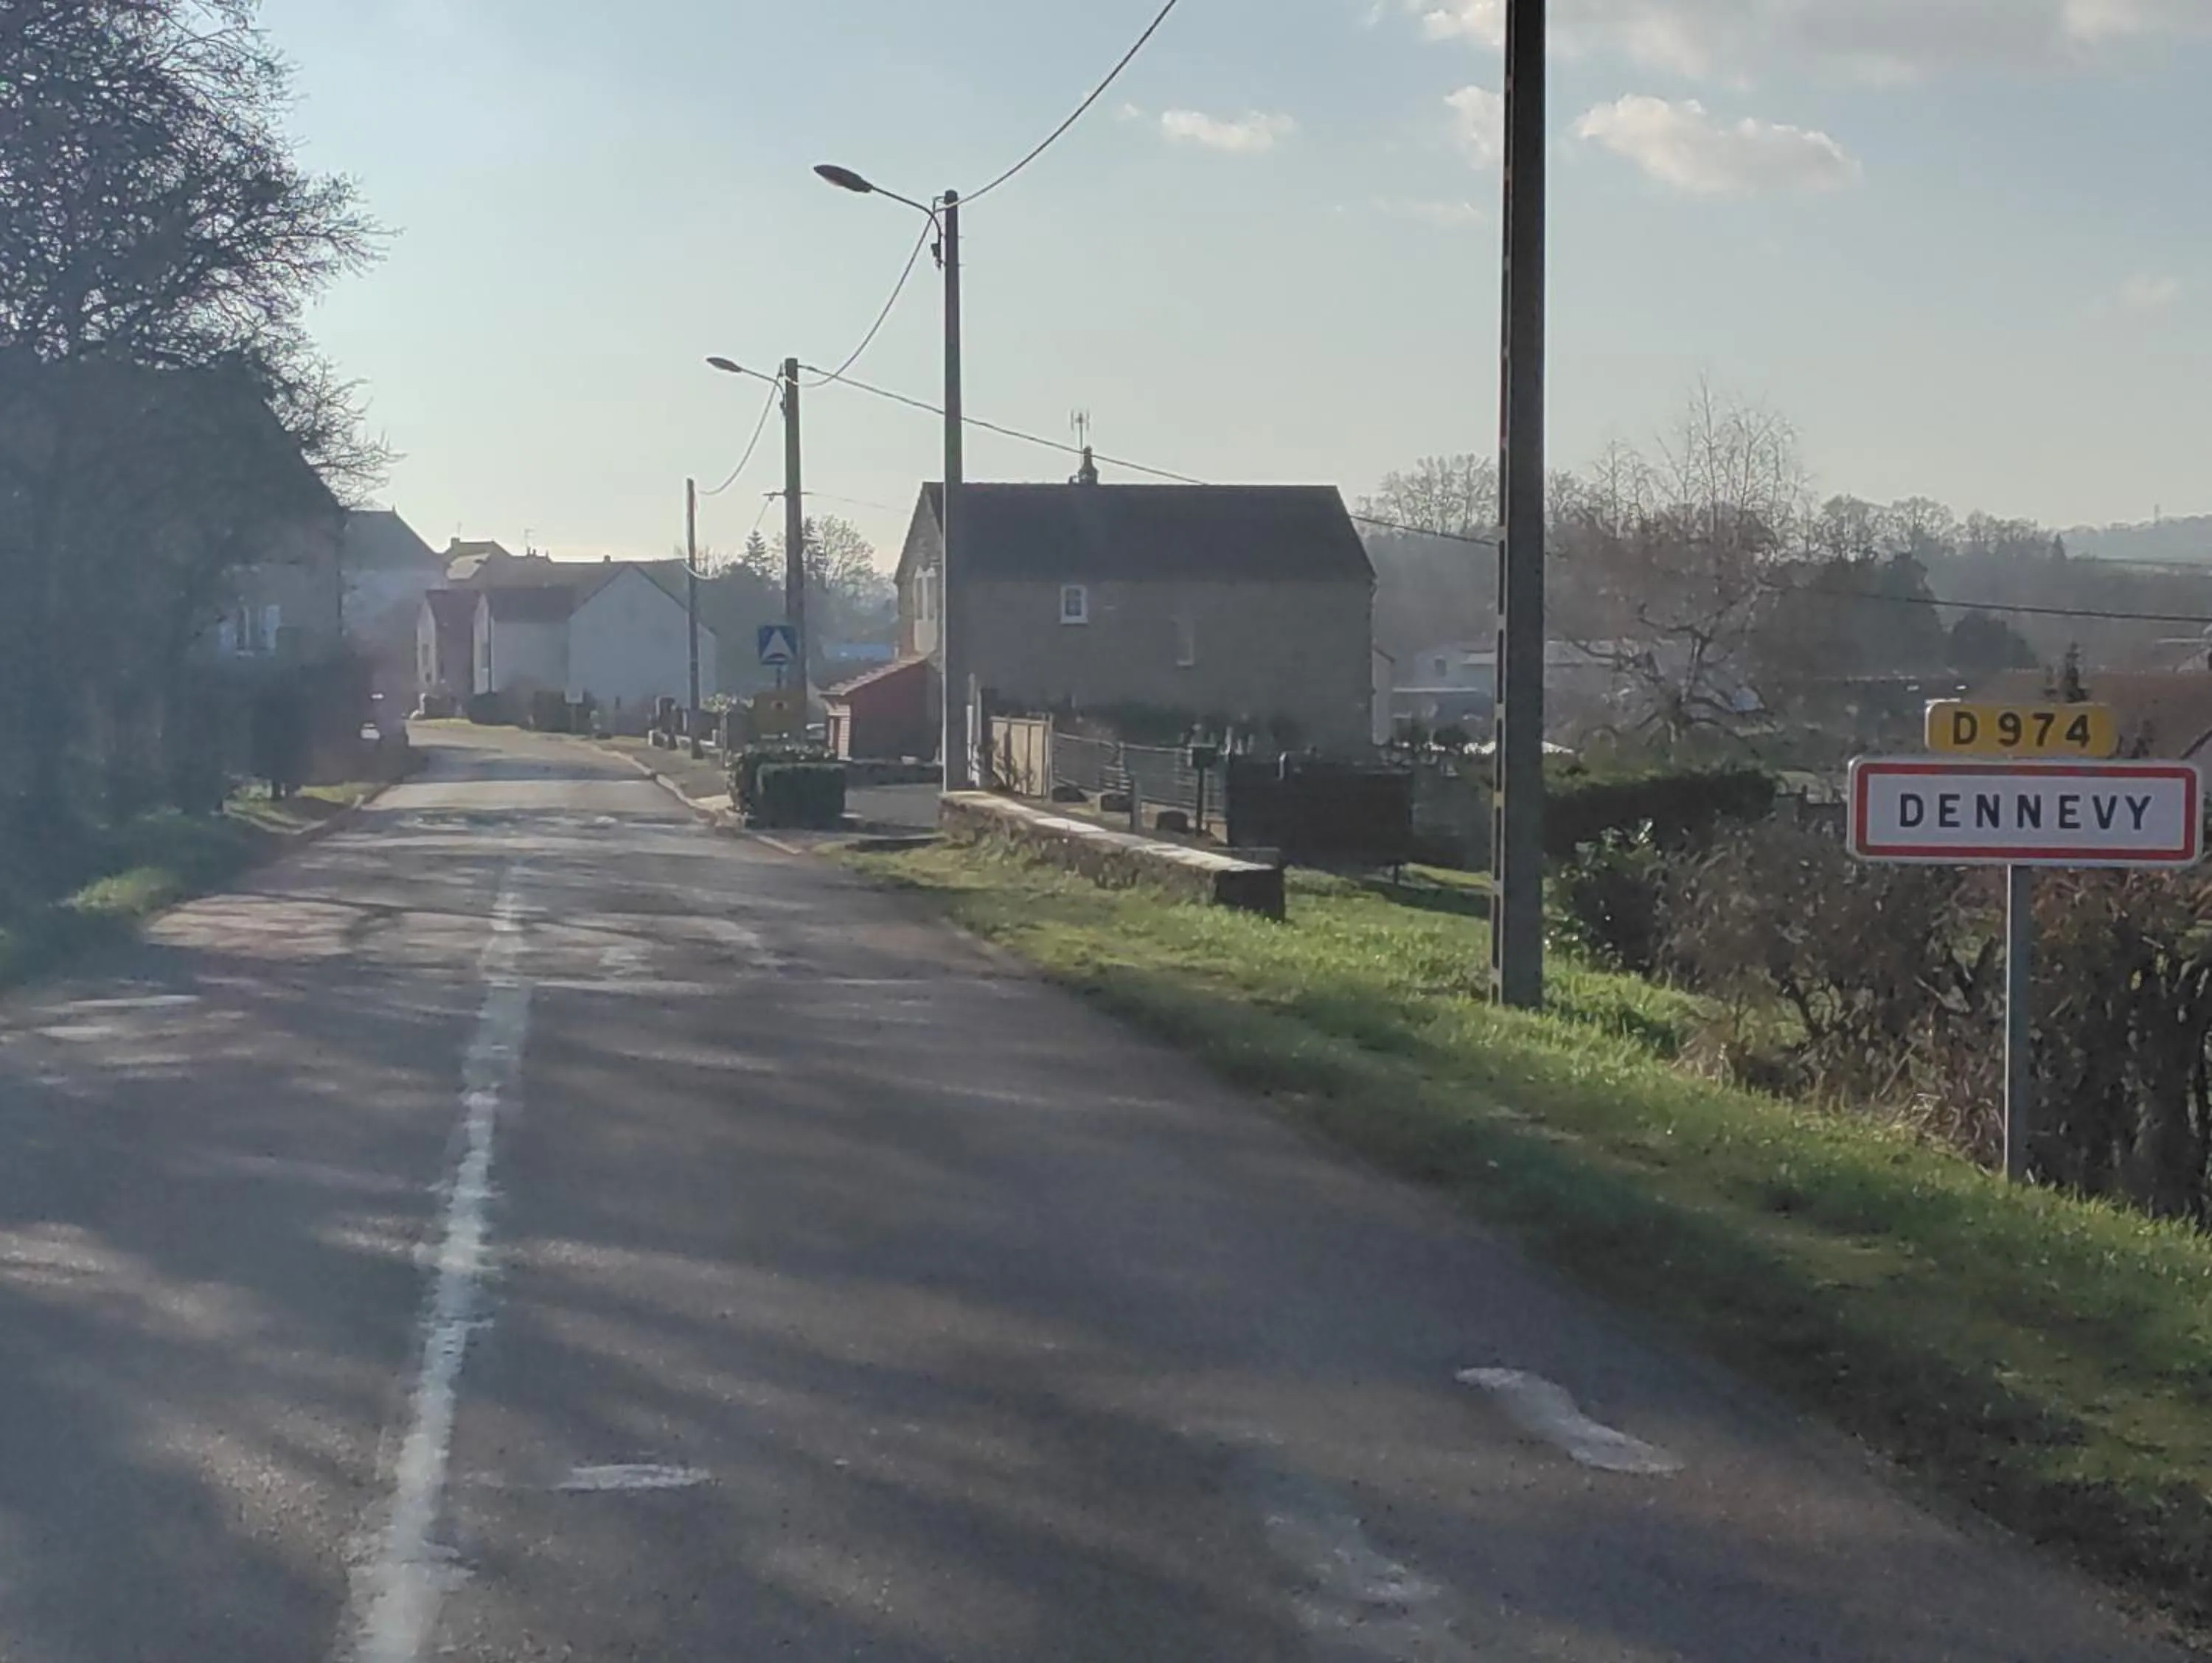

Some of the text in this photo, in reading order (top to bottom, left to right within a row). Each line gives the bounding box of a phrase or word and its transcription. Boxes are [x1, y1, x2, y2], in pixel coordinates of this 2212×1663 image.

[1952, 711, 2090, 747] D 974
[1899, 793, 2152, 830] DENNEVY
